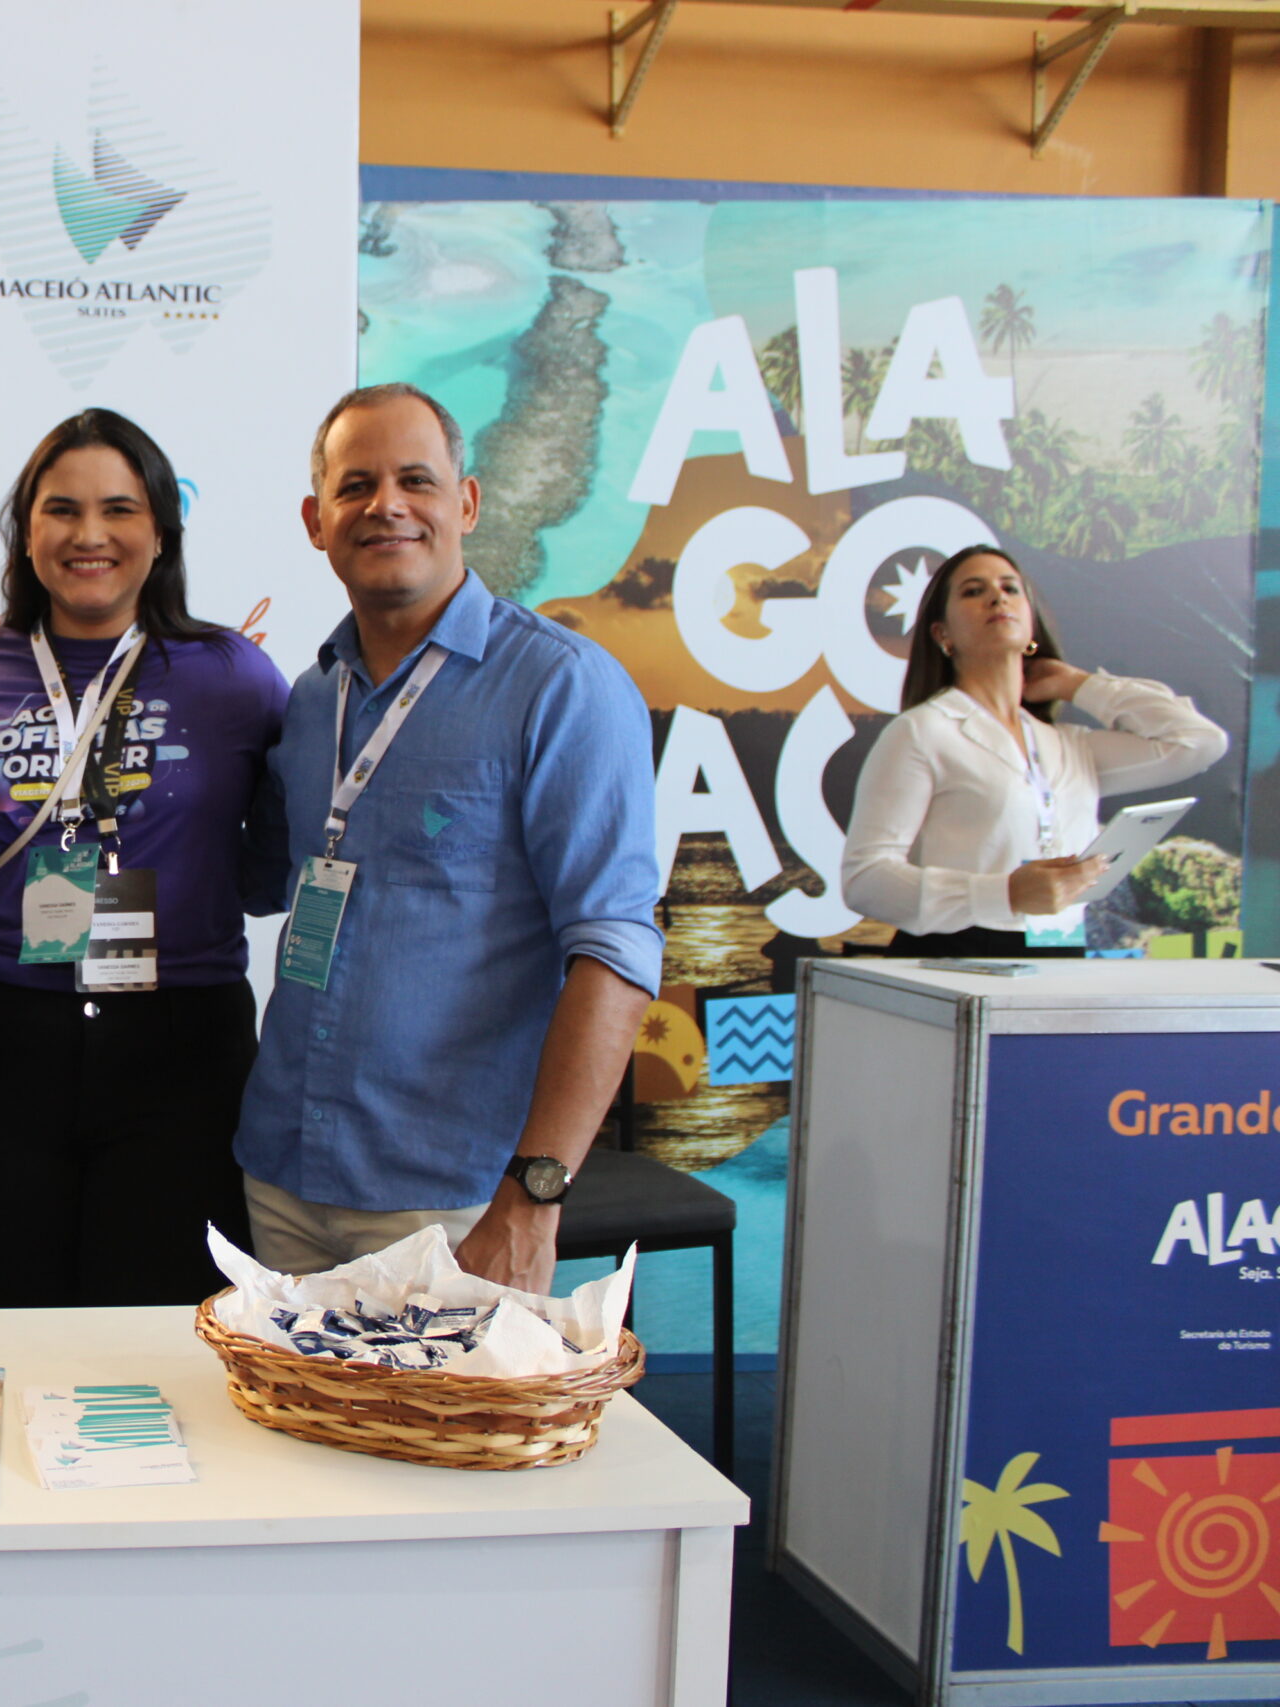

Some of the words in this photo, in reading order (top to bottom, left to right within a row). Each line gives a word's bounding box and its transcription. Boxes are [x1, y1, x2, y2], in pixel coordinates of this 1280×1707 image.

[95, 282, 222, 304] ATLANTIC
[77, 306, 127, 318] SUITES
[627, 266, 1014, 506] ALA
[116, 688, 134, 715] VIP
[104, 762, 121, 798] VIP
[1151, 1191, 1280, 1266] ALA
[1238, 1266, 1274, 1283] Seja.
[1179, 1329, 1225, 1339] Secretaria
[1226, 1329, 1238, 1339] de
[1239, 1328, 1272, 1338] Estado
[1233, 1340, 1271, 1350] Turismo
